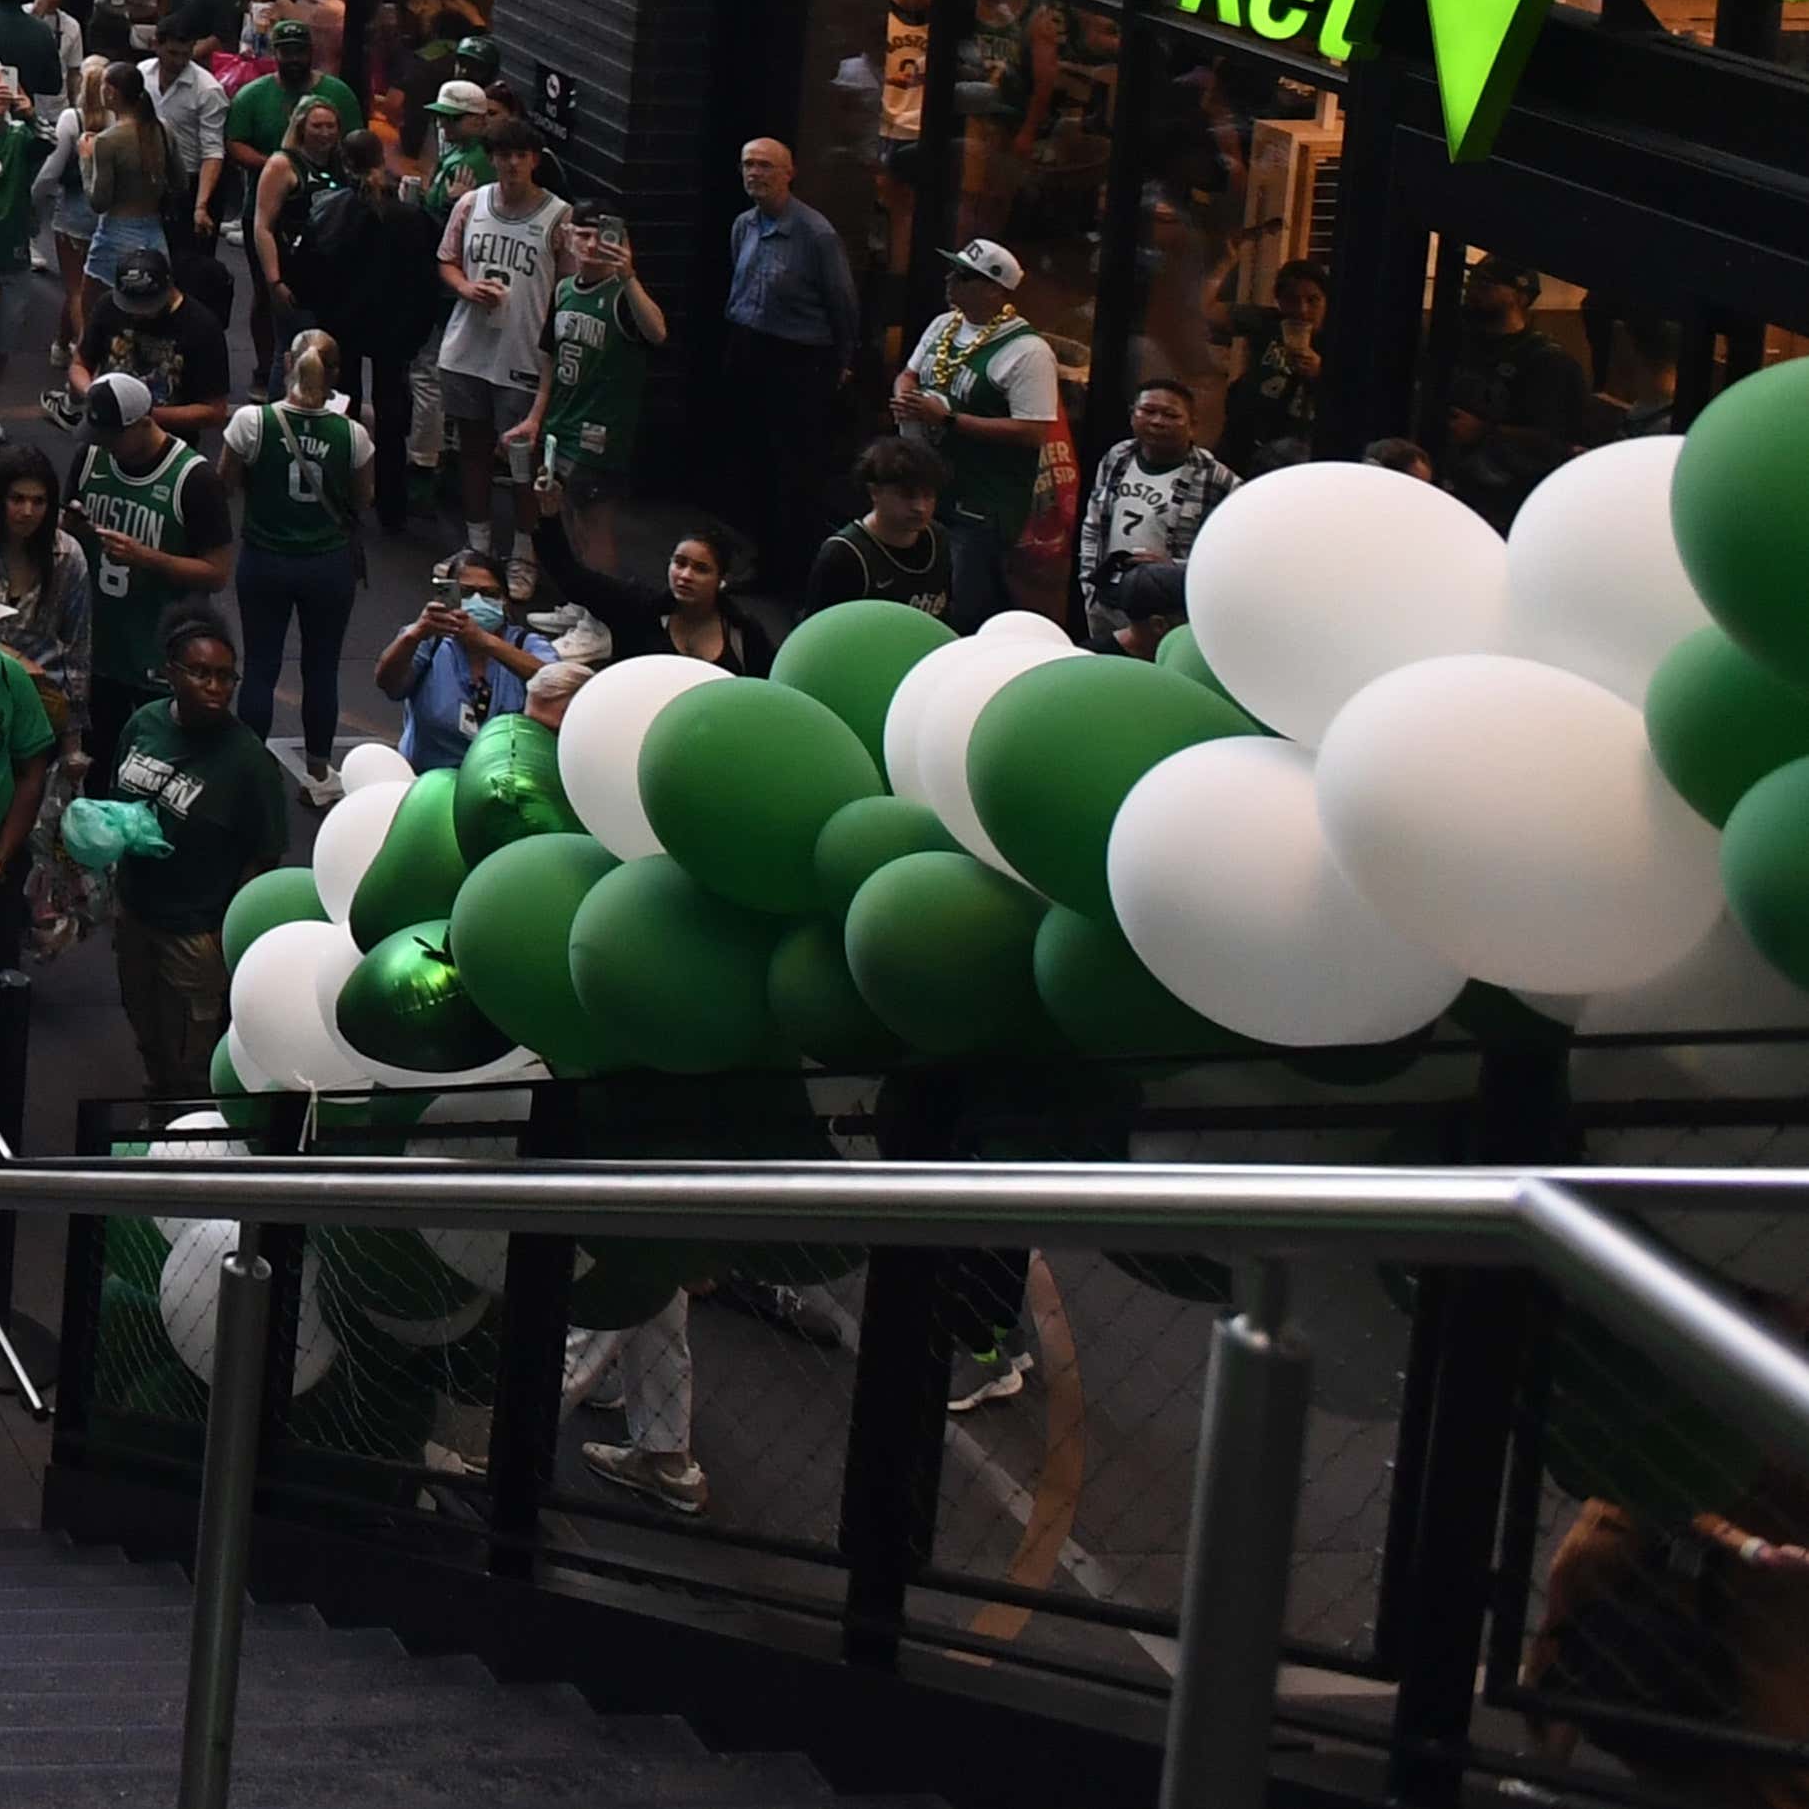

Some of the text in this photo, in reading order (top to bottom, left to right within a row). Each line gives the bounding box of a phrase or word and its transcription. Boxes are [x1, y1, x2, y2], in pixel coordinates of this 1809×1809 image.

[471, 232, 538, 277] CELTICS
[558, 342, 584, 385] 5
[281, 437, 331, 461] TTUM
[288, 461, 324, 502] 0
[1122, 509, 1145, 537] 7
